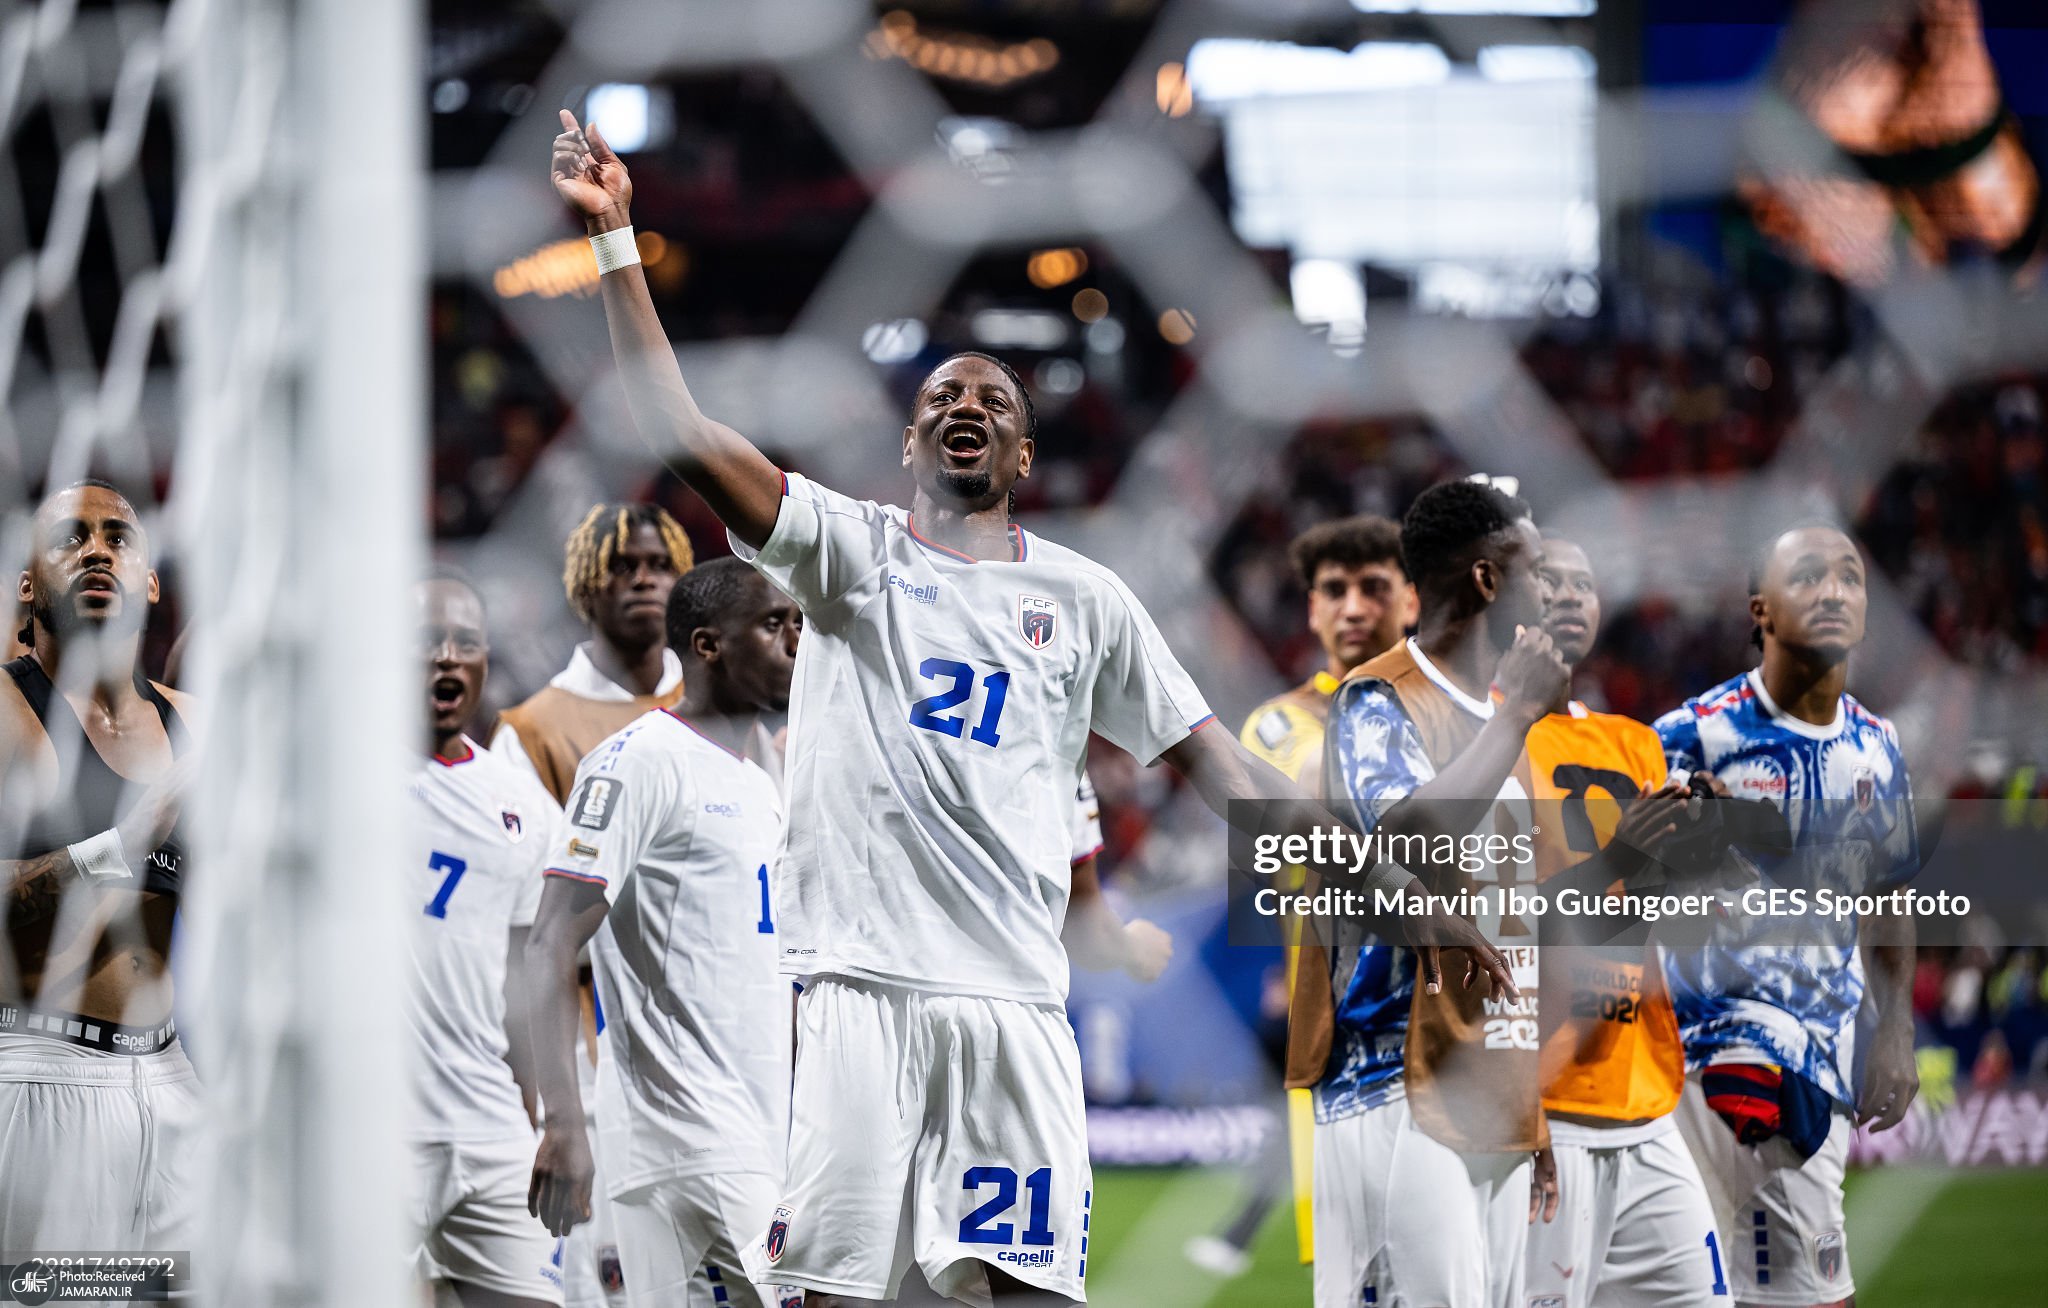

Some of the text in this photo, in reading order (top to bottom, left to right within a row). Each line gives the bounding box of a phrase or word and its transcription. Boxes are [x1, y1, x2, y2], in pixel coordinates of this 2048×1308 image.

[888, 575, 939, 601] capelli
[1022, 597, 1055, 609] FCF
[908, 657, 1011, 748] 21
[424, 851, 468, 919] 7
[112, 1030, 154, 1051] capelli
[958, 1166, 1055, 1246] 21
[997, 1249, 1055, 1266] capelli
